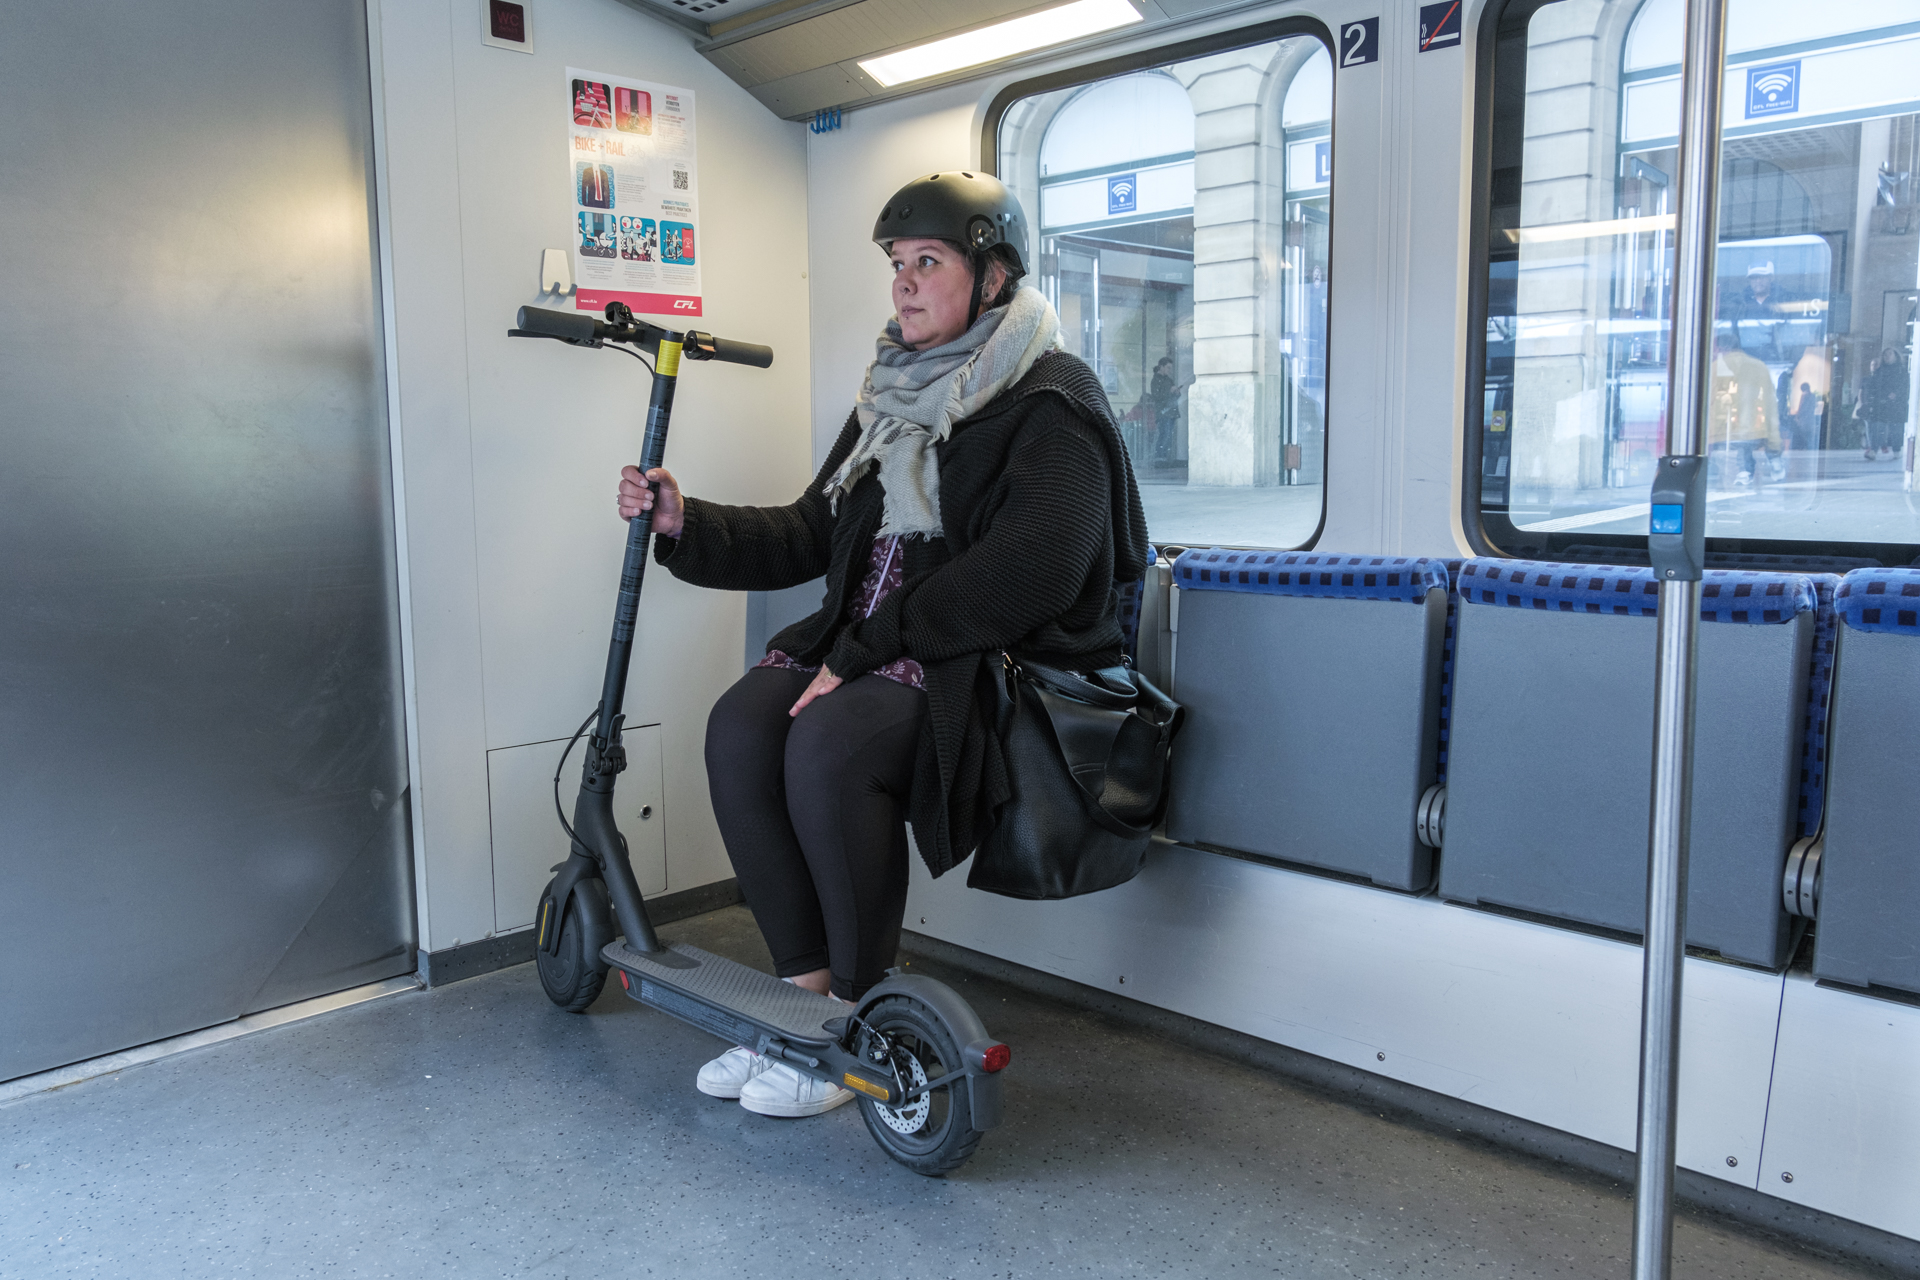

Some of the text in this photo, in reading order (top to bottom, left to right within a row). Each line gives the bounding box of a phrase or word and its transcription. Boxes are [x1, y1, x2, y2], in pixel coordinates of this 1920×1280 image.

[496, 10, 519, 27] WC
[1344, 23, 1366, 66] 2
[574, 135, 596, 153] BIKE
[605, 139, 626, 157] RAIL
[673, 299, 698, 310] CFL
